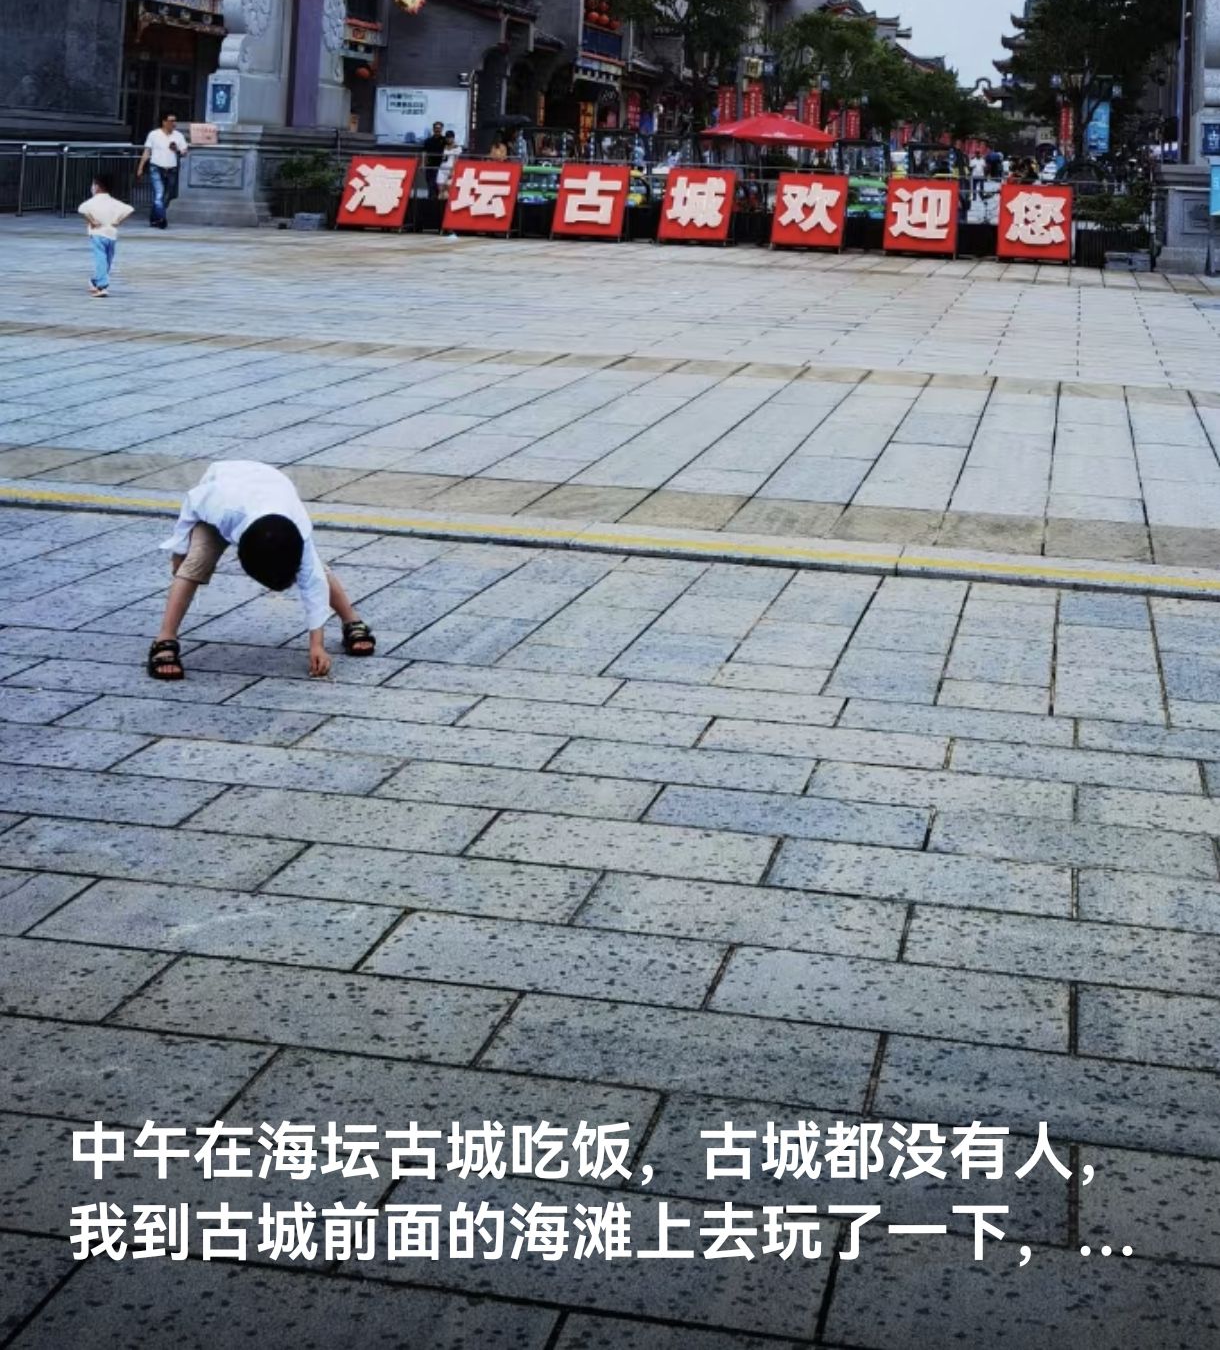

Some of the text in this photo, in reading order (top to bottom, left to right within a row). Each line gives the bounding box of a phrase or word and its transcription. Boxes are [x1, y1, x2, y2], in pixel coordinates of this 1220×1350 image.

[344, 163, 1067, 245] 海坛古城欢迎您
